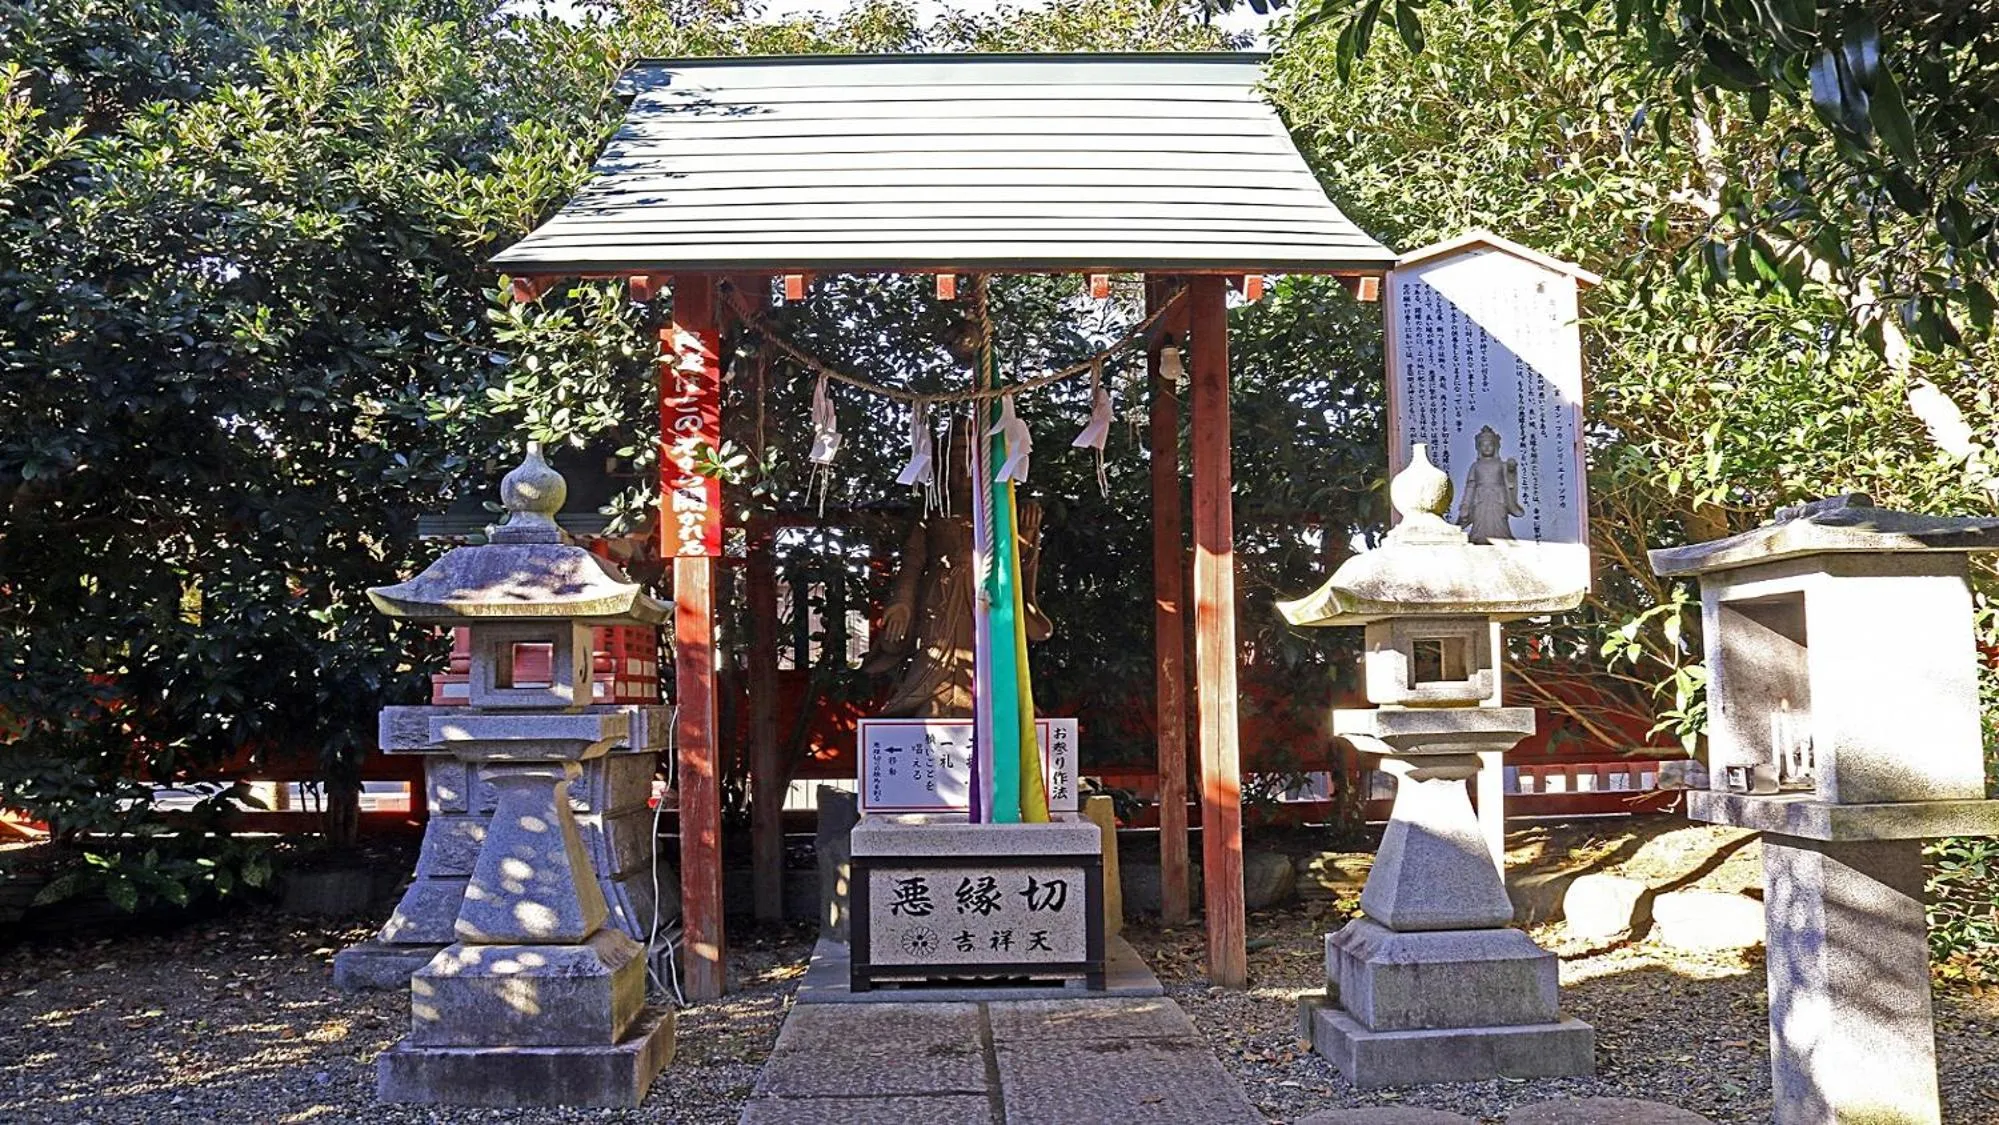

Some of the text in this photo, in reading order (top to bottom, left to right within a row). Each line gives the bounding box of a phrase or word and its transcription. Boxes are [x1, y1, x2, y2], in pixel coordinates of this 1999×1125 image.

[911, 743, 922, 780] 唱える
[940, 741, 954, 769] 一礼
[1052, 727, 1068, 800] お参り作法
[890, 875, 1068, 917] 悪縁切
[951, 930, 1053, 952] 吉祥天
